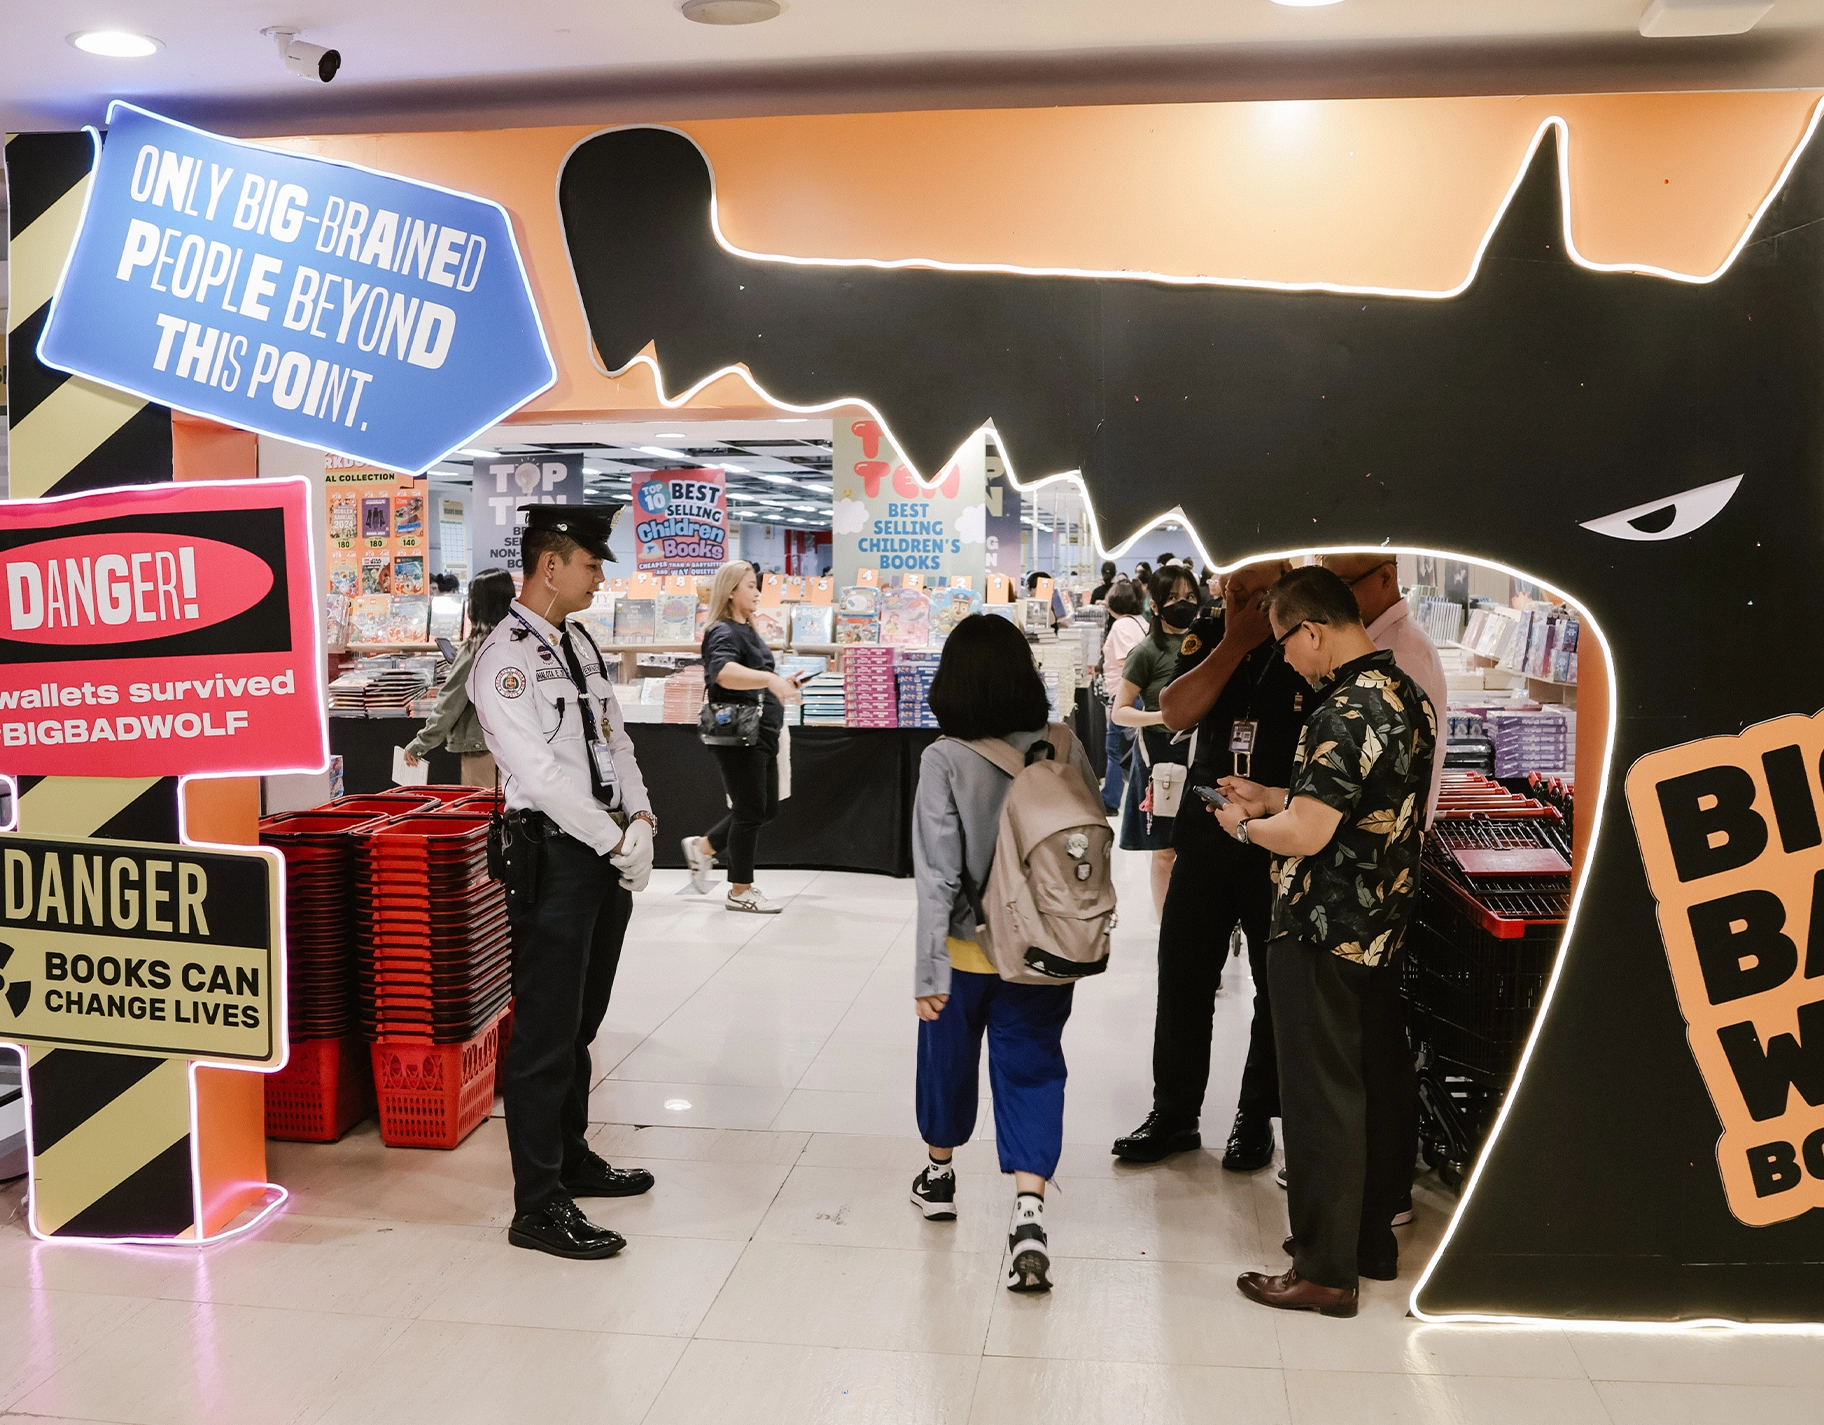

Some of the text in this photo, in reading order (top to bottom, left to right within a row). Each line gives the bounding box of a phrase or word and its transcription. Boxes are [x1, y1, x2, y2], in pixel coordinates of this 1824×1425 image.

[130, 144, 487, 292] ONLY BIG-BRAINED
[116, 218, 457, 371] PEOPLE BEYOND
[153, 313, 374, 432] THIS POINT.
[339, 473, 395, 482] COLLECTION
[489, 461, 568, 494] TOP
[642, 483, 663, 496] TOP
[672, 482, 720, 504] BEST
[488, 495, 567, 525] TE
[644, 493, 666, 511] 10
[888, 503, 929, 518] BEST
[667, 504, 722, 523] SELLING
[333, 520, 353, 528] 2024
[637, 517, 725, 544] Children
[874, 521, 943, 536] SELLING
[664, 539, 724, 560] Books
[858, 538, 961, 553] CHILDREN'S
[670, 568, 688, 576] WAY
[880, 555, 940, 570] BOOKS
[676, 576, 686, 587] 8
[817, 579, 828, 590] 5
[861, 570, 873, 581] 4
[907, 574, 919, 586] 3
[955, 577, 967, 588] 2
[6, 546, 199, 631] DANGER!
[0, 669, 296, 710] wallets survived
[0, 710, 249, 747] BIGBADWOLF
[1655, 744, 1824, 883] BI
[4, 848, 210, 936] DANGER
[45, 951, 259, 997] BOOKS CAN
[45, 990, 260, 1029] CHANGE LIVES
